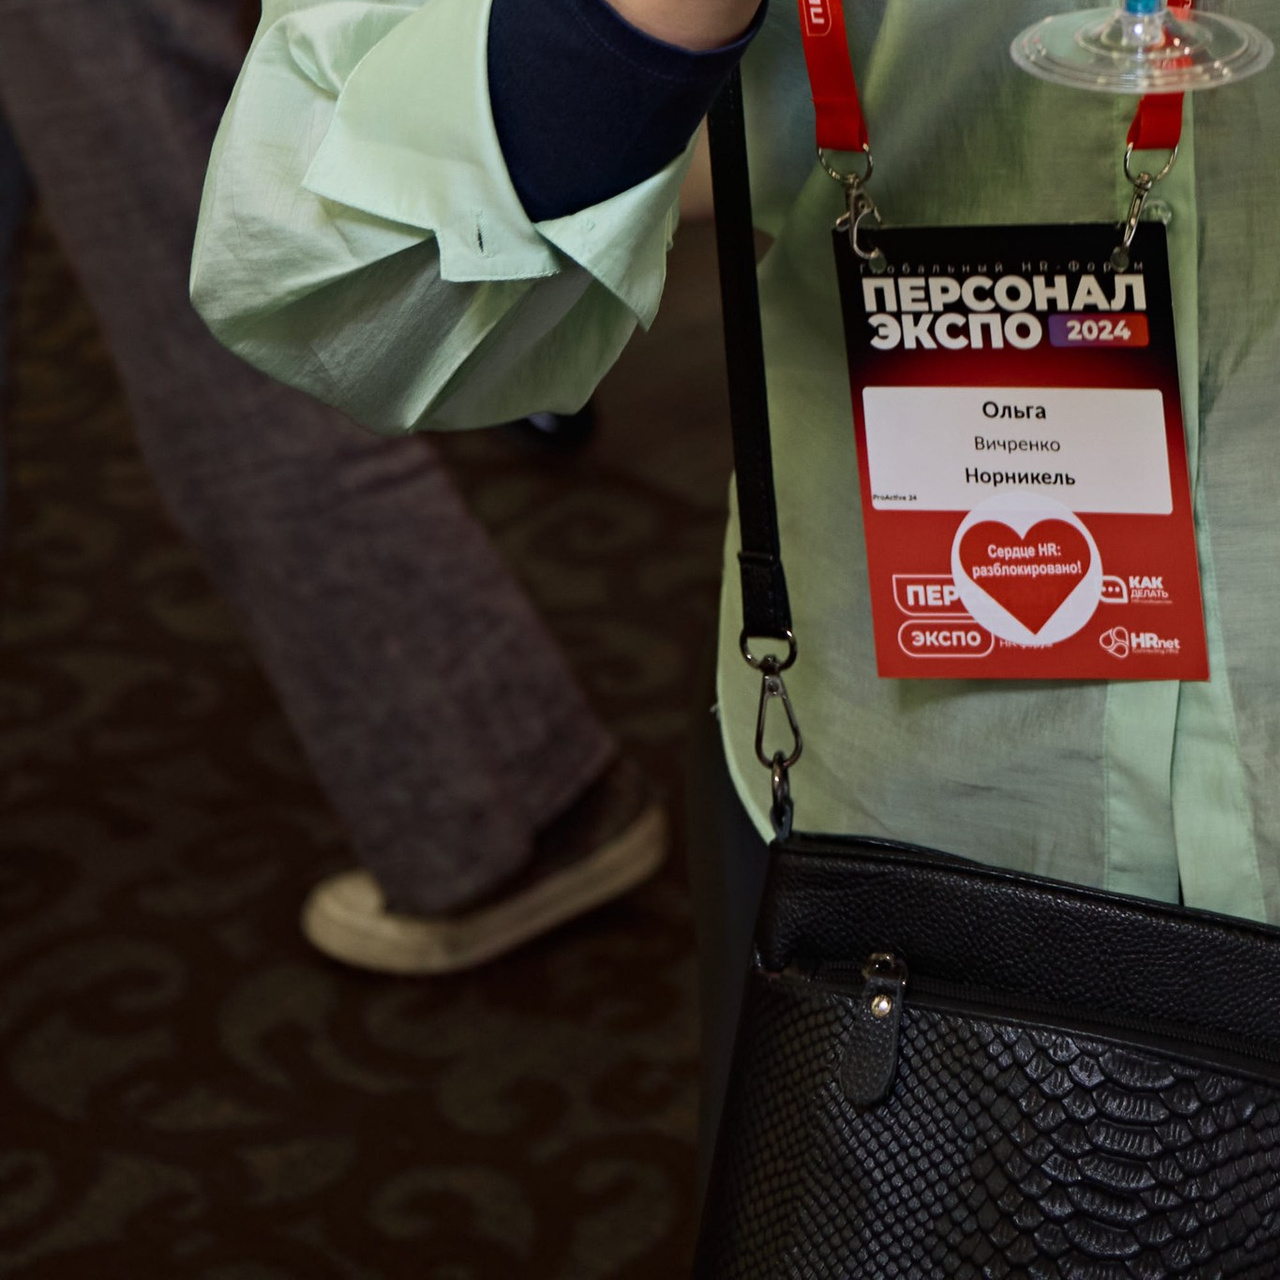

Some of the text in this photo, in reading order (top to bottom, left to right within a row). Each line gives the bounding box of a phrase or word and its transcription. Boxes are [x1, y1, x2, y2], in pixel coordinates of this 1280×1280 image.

[859, 259, 1144, 274] Гобальный HR-Форм
[861, 274, 1147, 313] ПЕРСОНАЛ
[867, 312, 1132, 350] ЭКСПО 2024
[982, 400, 1047, 420] Ольга
[973, 435, 1061, 454] Вичренко
[964, 467, 1076, 487] Норникель
[987, 542, 1062, 560] Сердце HR:
[971, 560, 1082, 579] разблокировано!
[1128, 576, 1164, 589] КАК
[1130, 589, 1169, 599] ДЕЛАТЬ
[911, 630, 982, 648] ЭКСПО
[1130, 632, 1180, 649] HRnet
